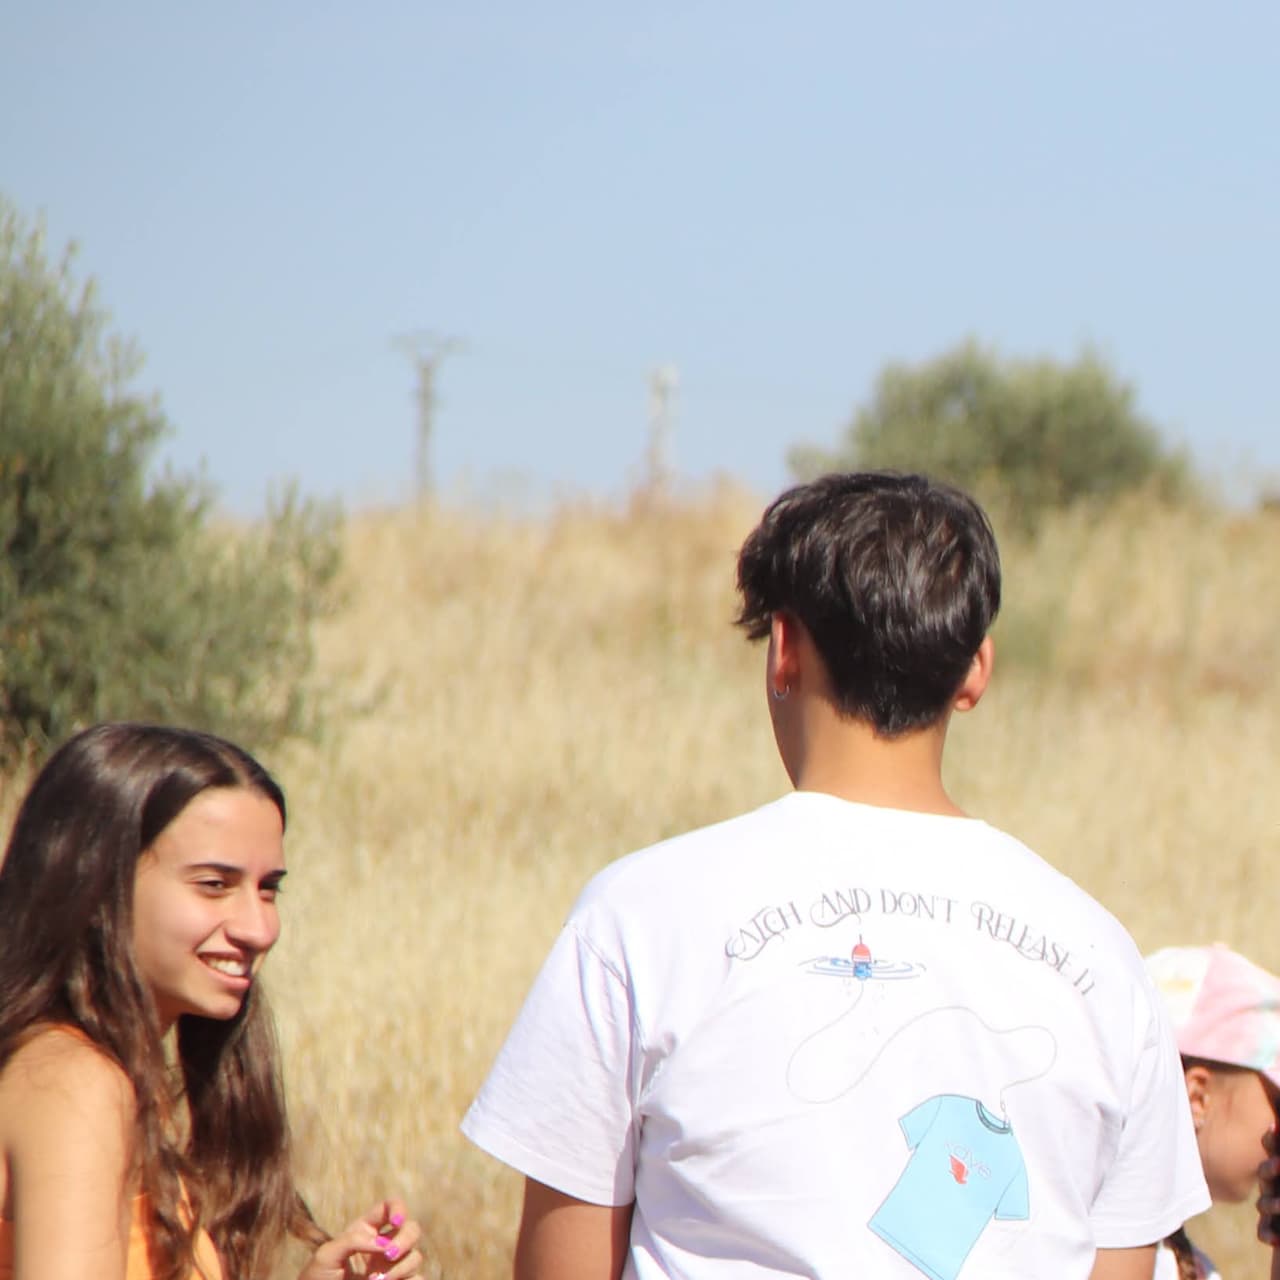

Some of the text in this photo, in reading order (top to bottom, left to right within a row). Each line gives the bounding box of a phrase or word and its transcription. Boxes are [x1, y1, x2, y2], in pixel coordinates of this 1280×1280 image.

[809, 888, 871, 928] AND
[880, 888, 958, 924] DON'T
[970, 901, 1072, 976] RELEASE
